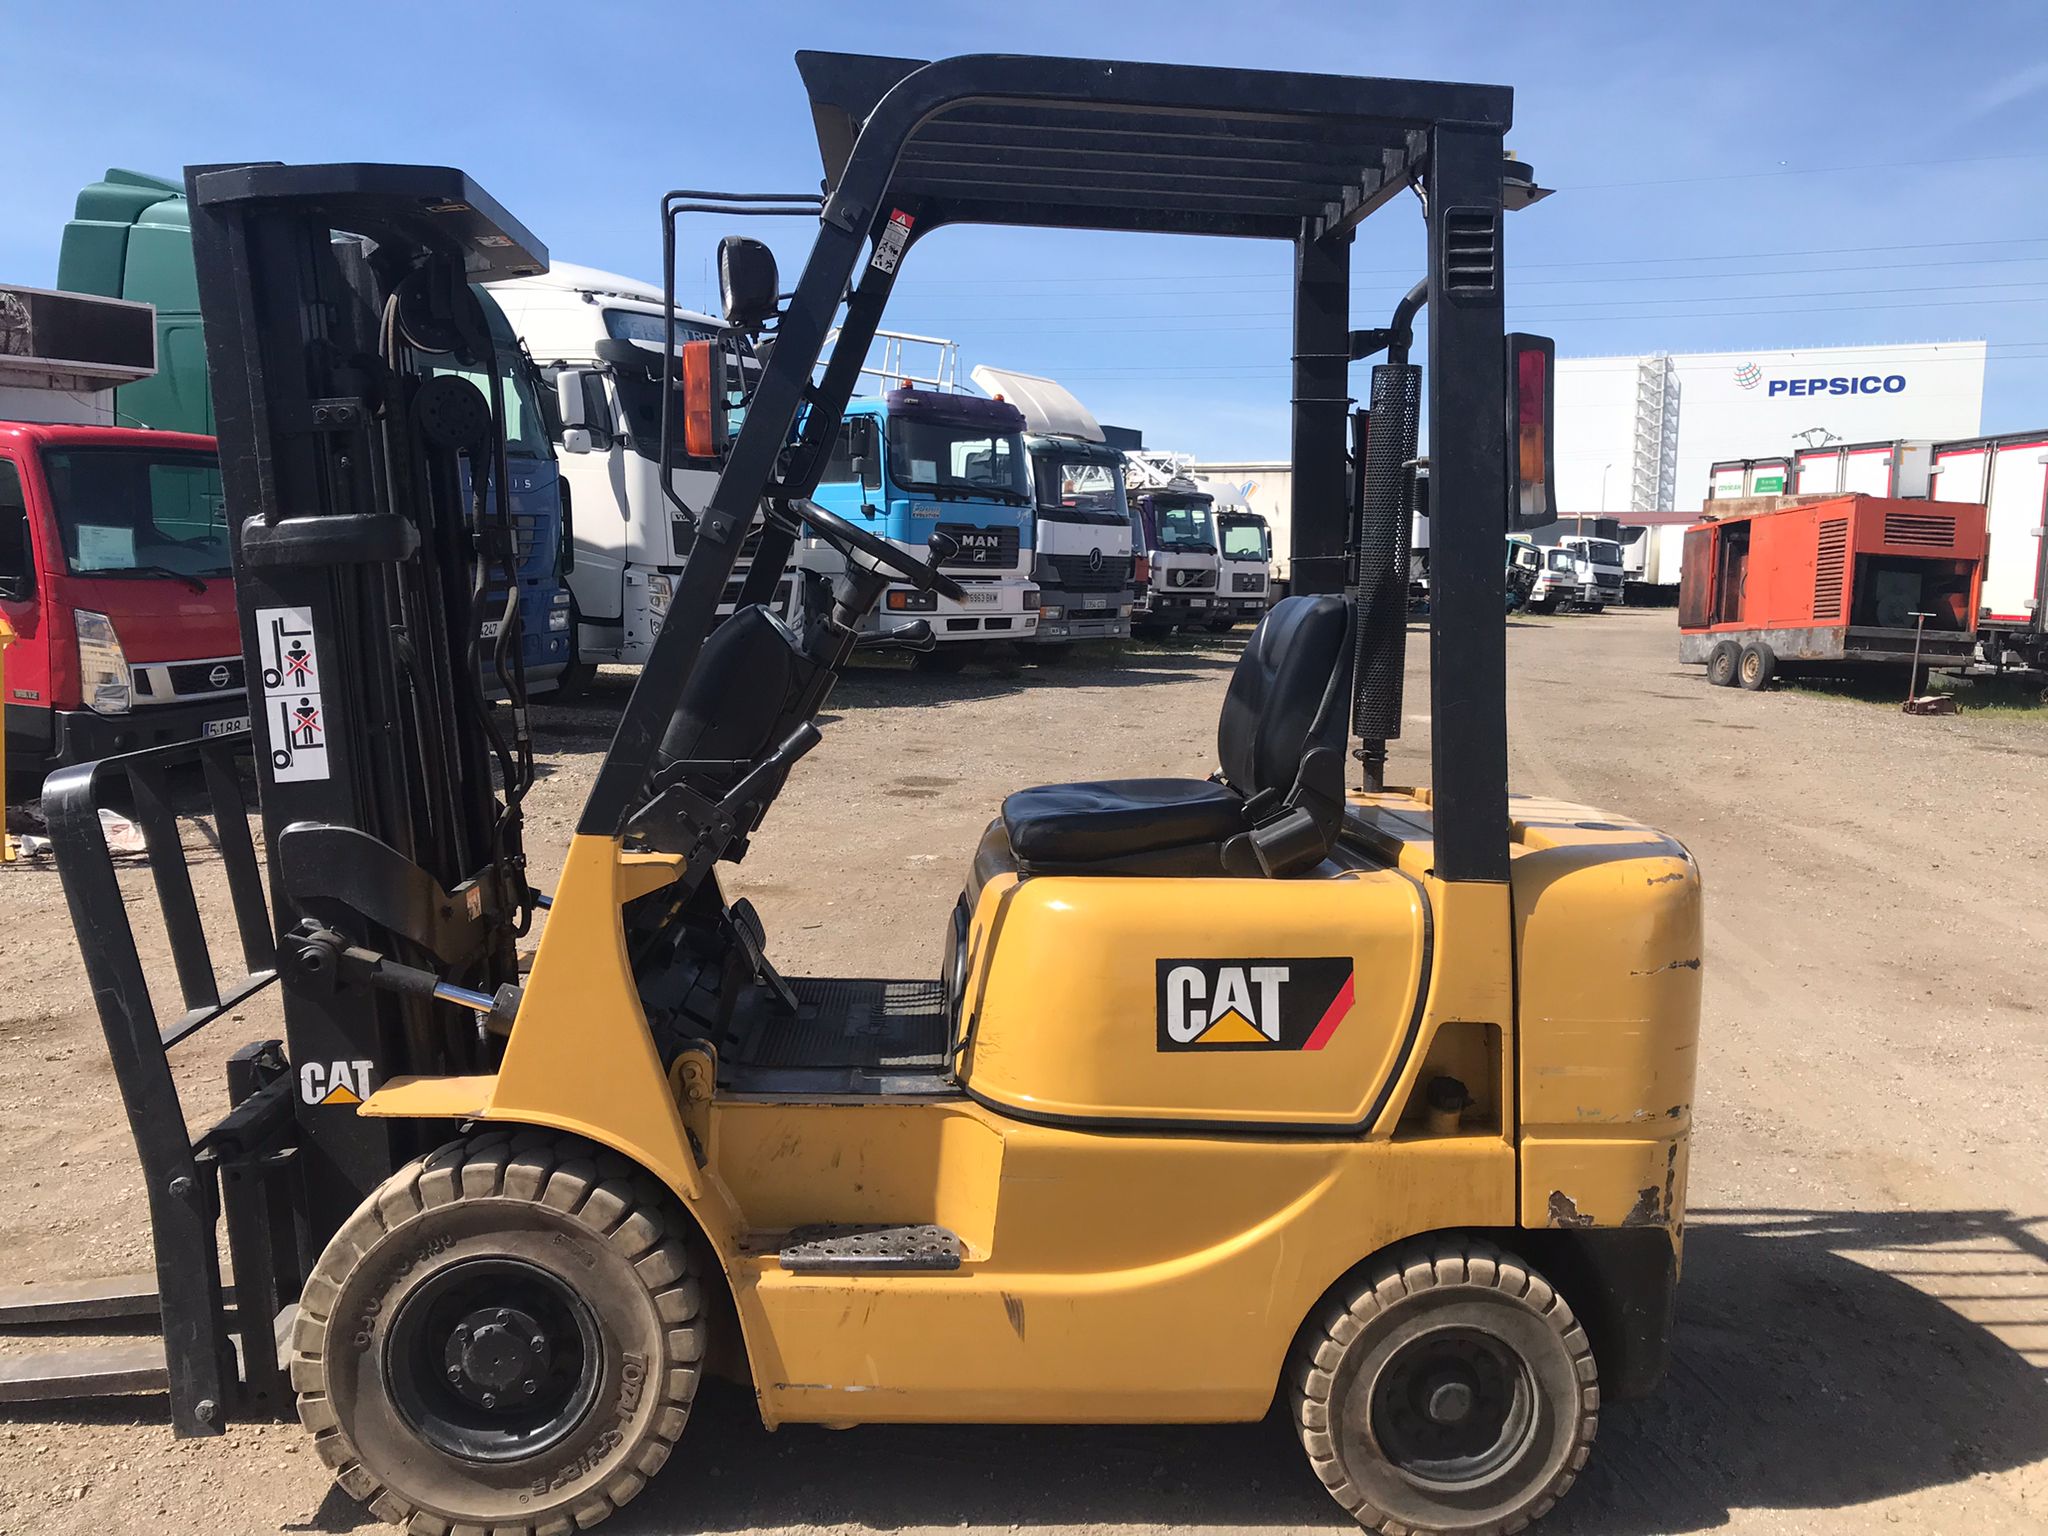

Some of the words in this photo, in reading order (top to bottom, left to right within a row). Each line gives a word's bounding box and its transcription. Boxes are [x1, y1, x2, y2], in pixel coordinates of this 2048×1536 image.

[1768, 375, 1906, 397] PEPSICO
[962, 535, 998, 547] MAN
[1167, 966, 1289, 1043] CAT
[300, 1060, 373, 1105] CAT
[615, 1352, 648, 1424] TOTAL
